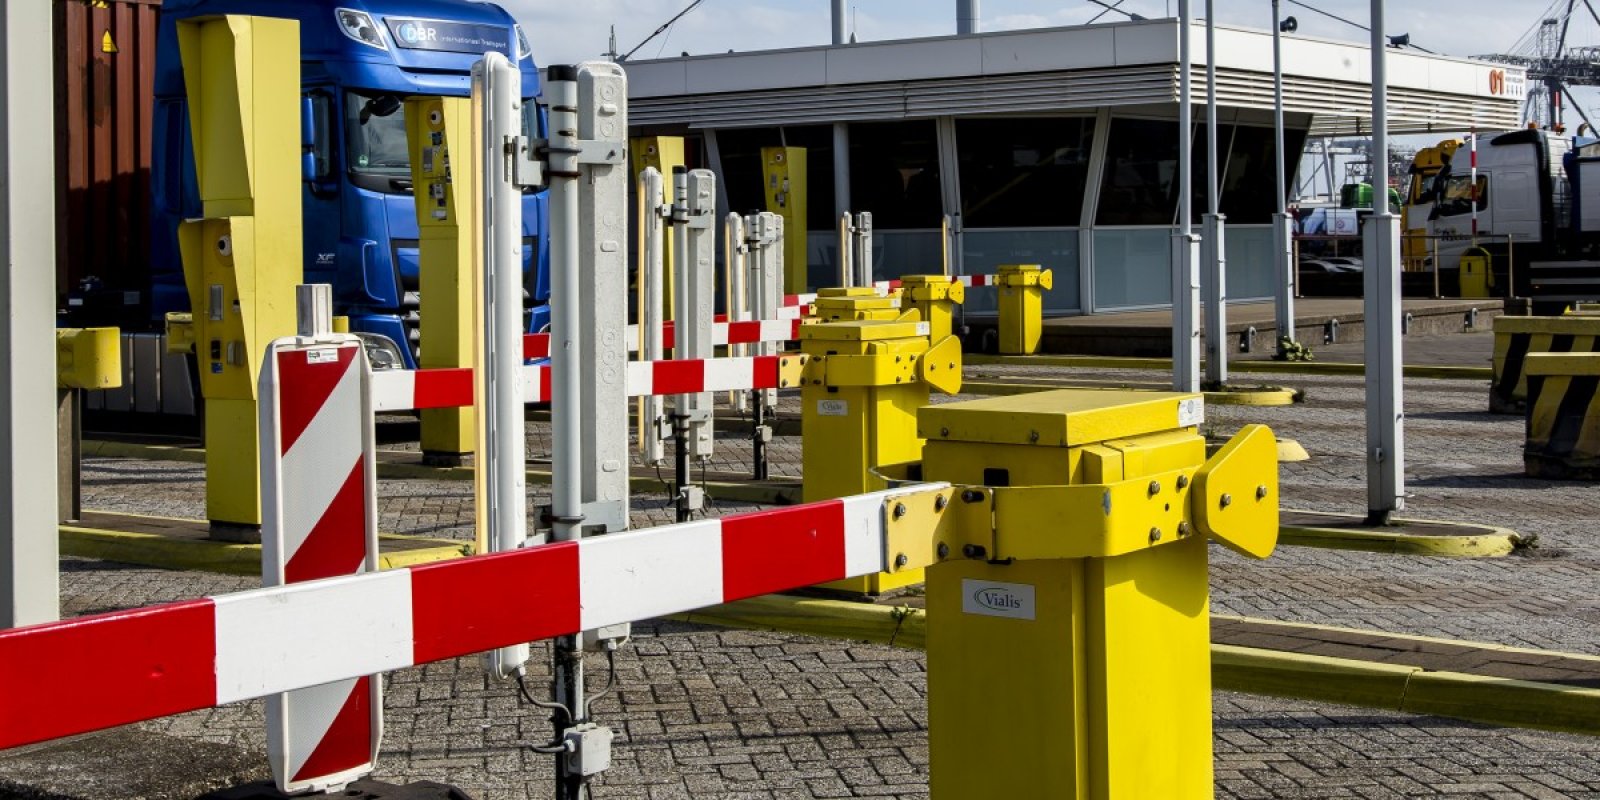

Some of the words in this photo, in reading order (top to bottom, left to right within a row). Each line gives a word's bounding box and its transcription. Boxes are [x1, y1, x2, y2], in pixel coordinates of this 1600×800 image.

[407, 27, 437, 41] DBR
[1489, 69, 1504, 95] 01
[985, 592, 1021, 609] Vialis
